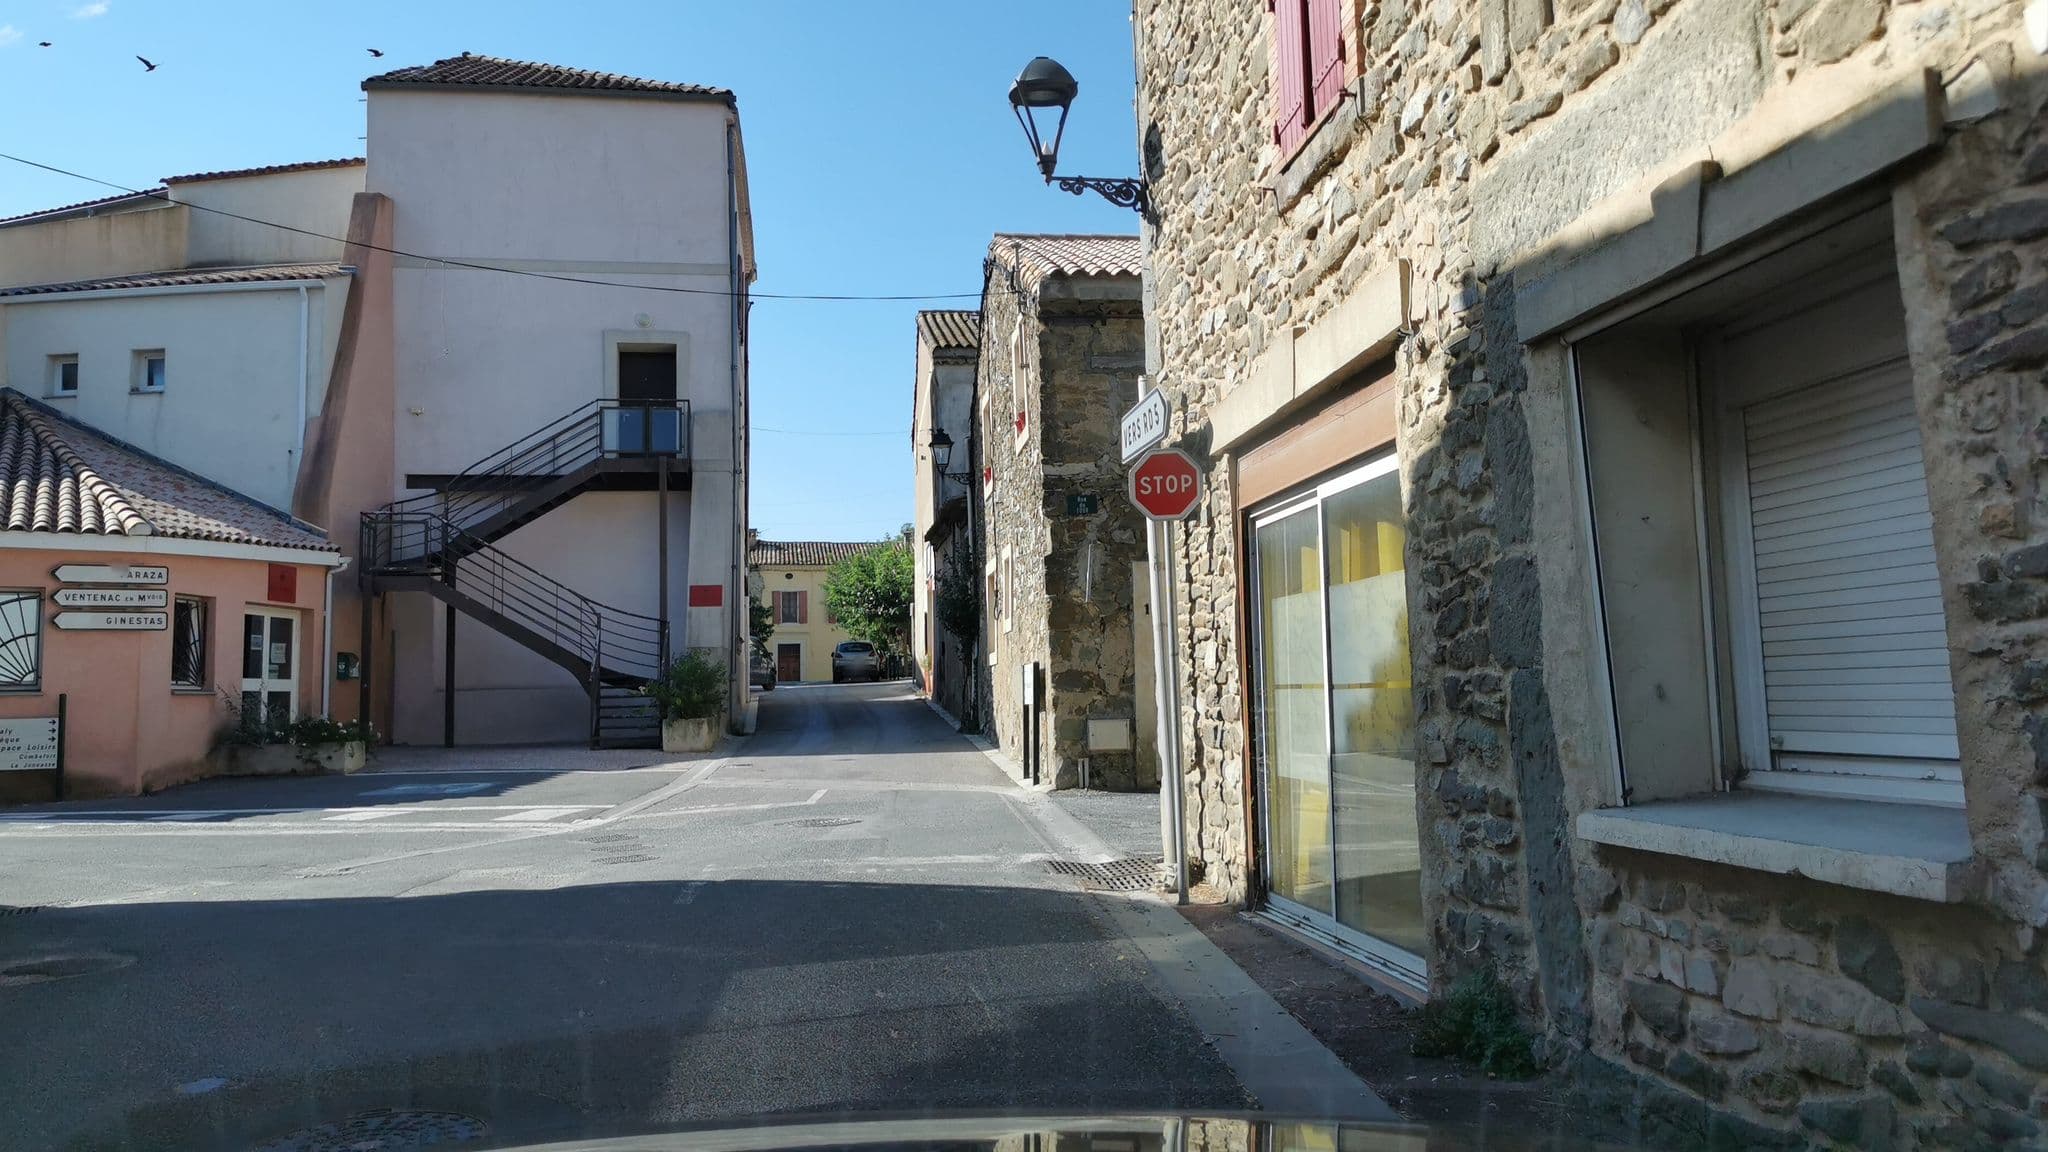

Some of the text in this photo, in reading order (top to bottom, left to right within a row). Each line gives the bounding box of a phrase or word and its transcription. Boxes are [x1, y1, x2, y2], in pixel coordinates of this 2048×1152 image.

[1124, 418, 1141, 448] VERS
[1140, 474, 1192, 494] STOP
[120, 571, 163, 579] ARAZA
[64, 593, 121, 602] VENTENAC
[106, 617, 163, 625] GINESTAS
